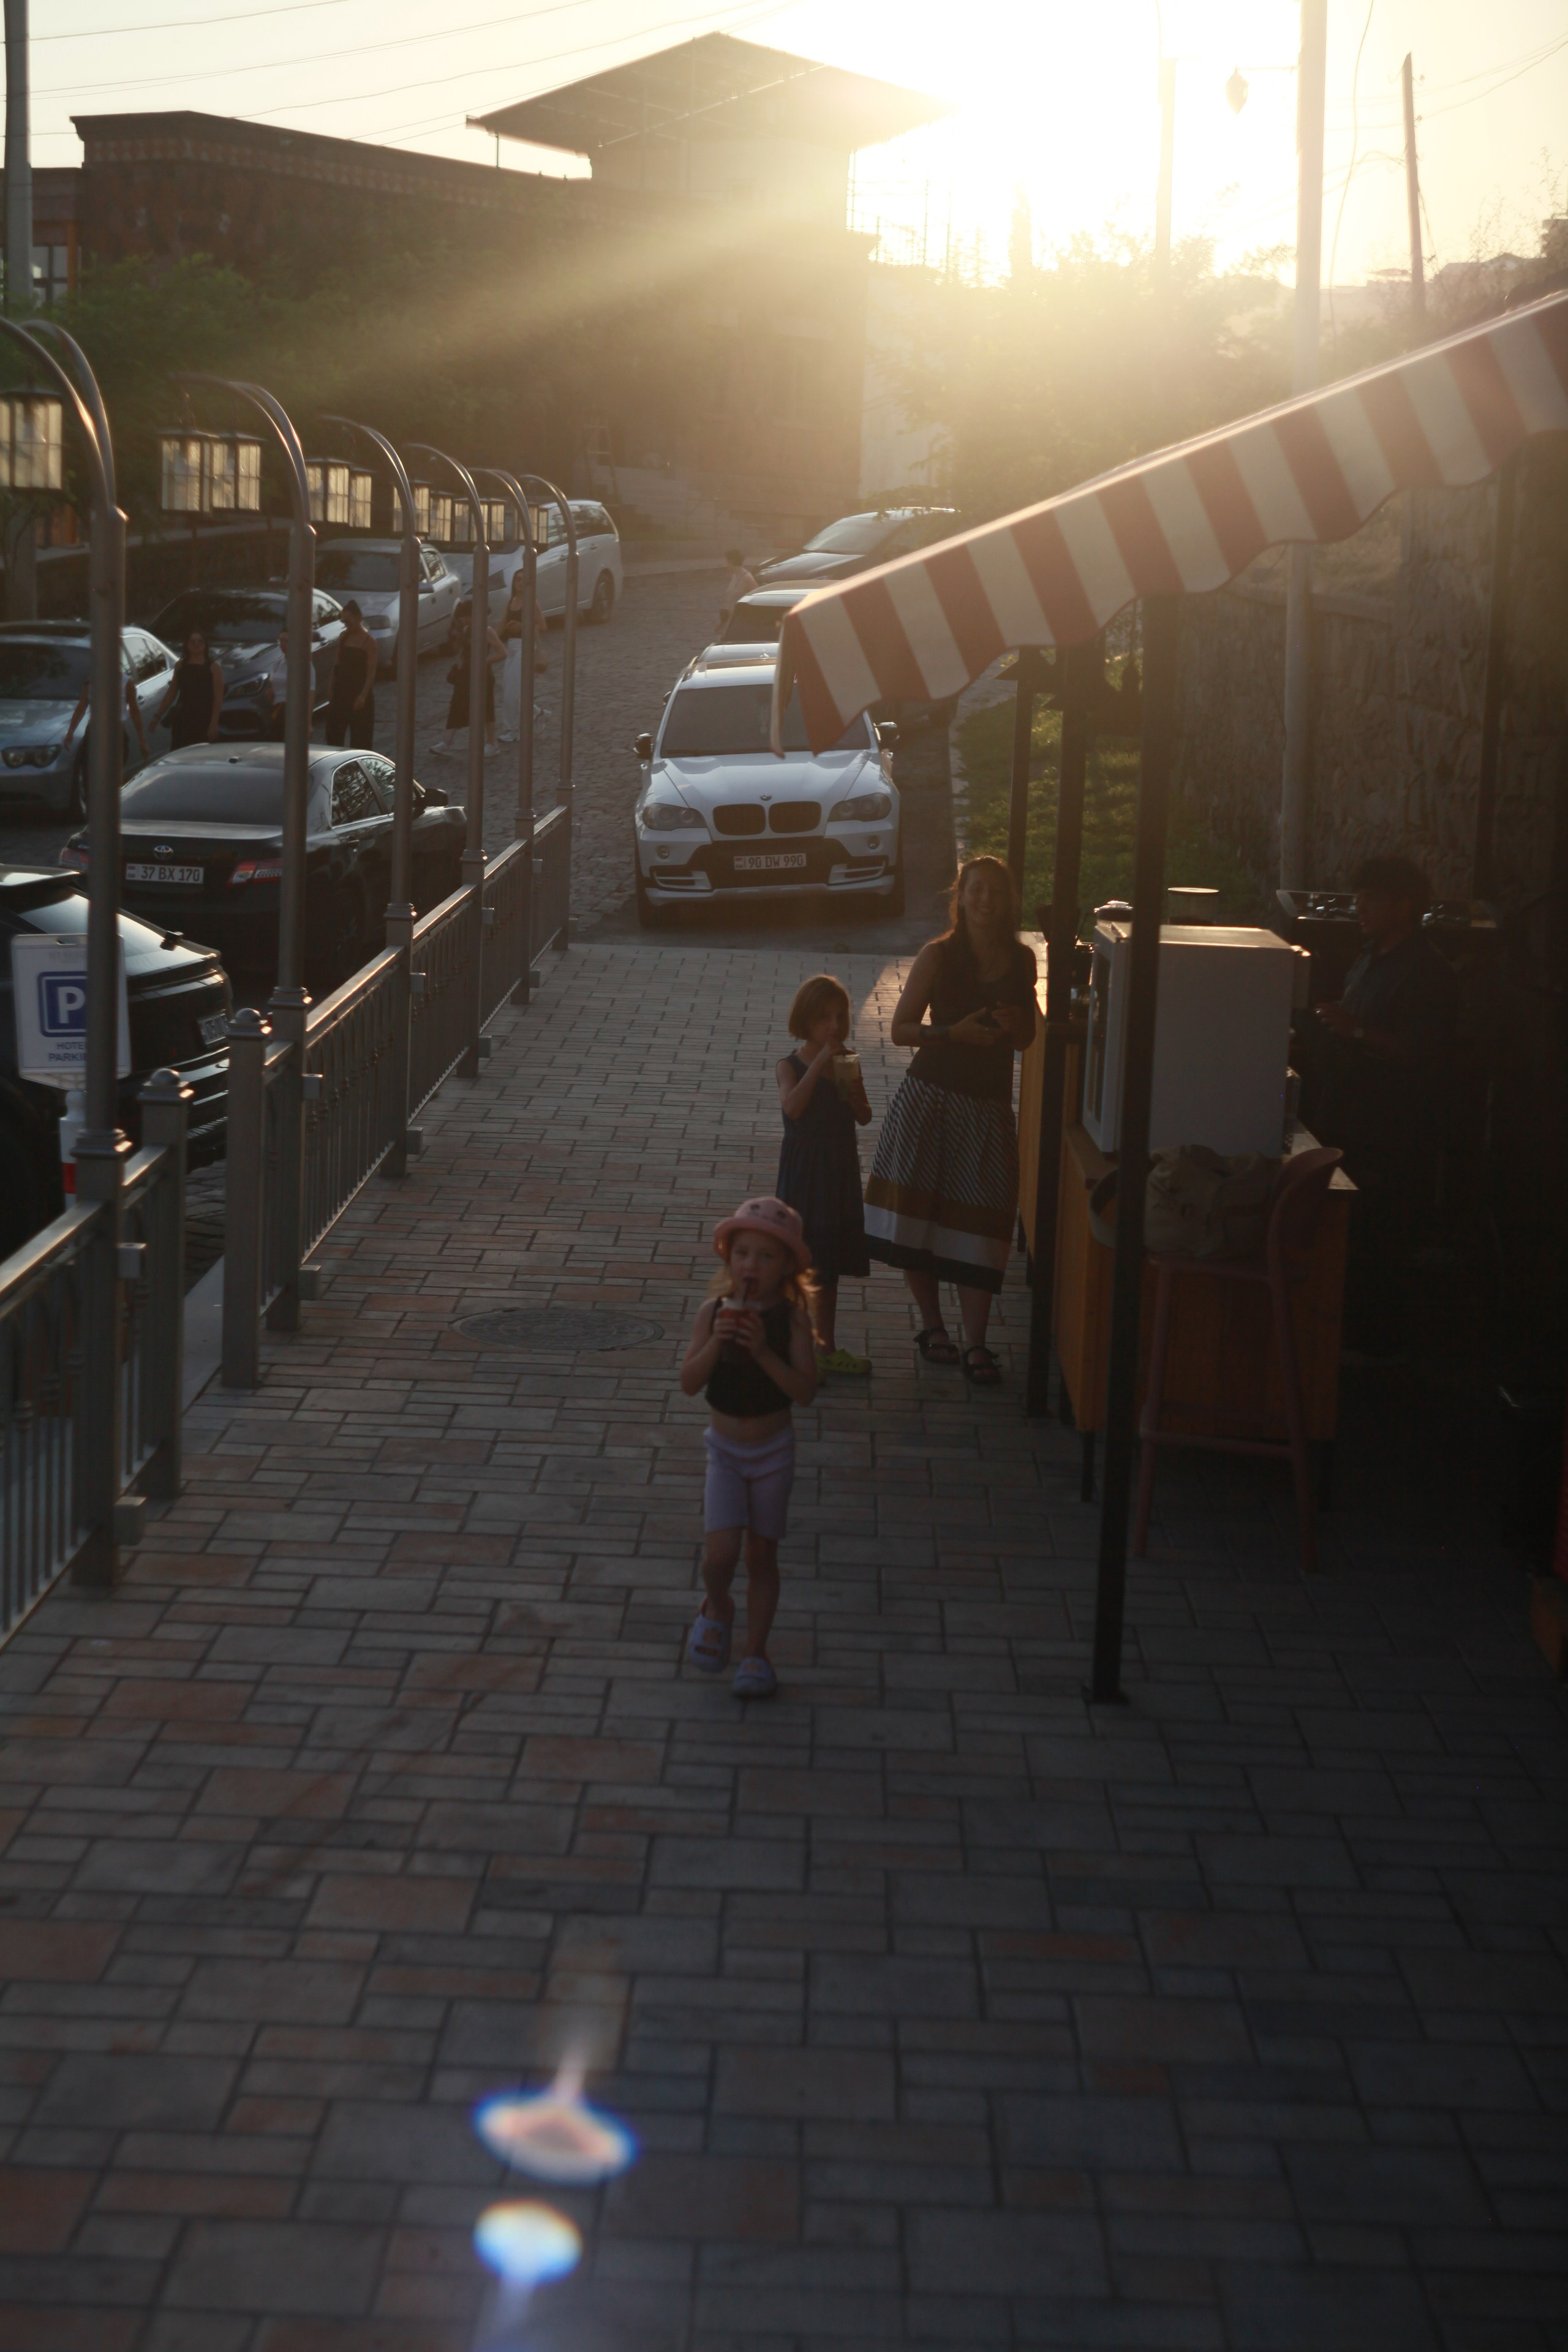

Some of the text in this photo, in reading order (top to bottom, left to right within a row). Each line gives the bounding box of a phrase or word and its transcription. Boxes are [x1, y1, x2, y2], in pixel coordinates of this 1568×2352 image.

[748, 856, 761, 868] 90
[765, 856, 780, 867] DW
[783, 854, 803, 867] 990
[141, 866, 200, 882] 37 BX 170
[57, 986, 85, 1024] P
[48, 1053, 87, 1061] PARKI
